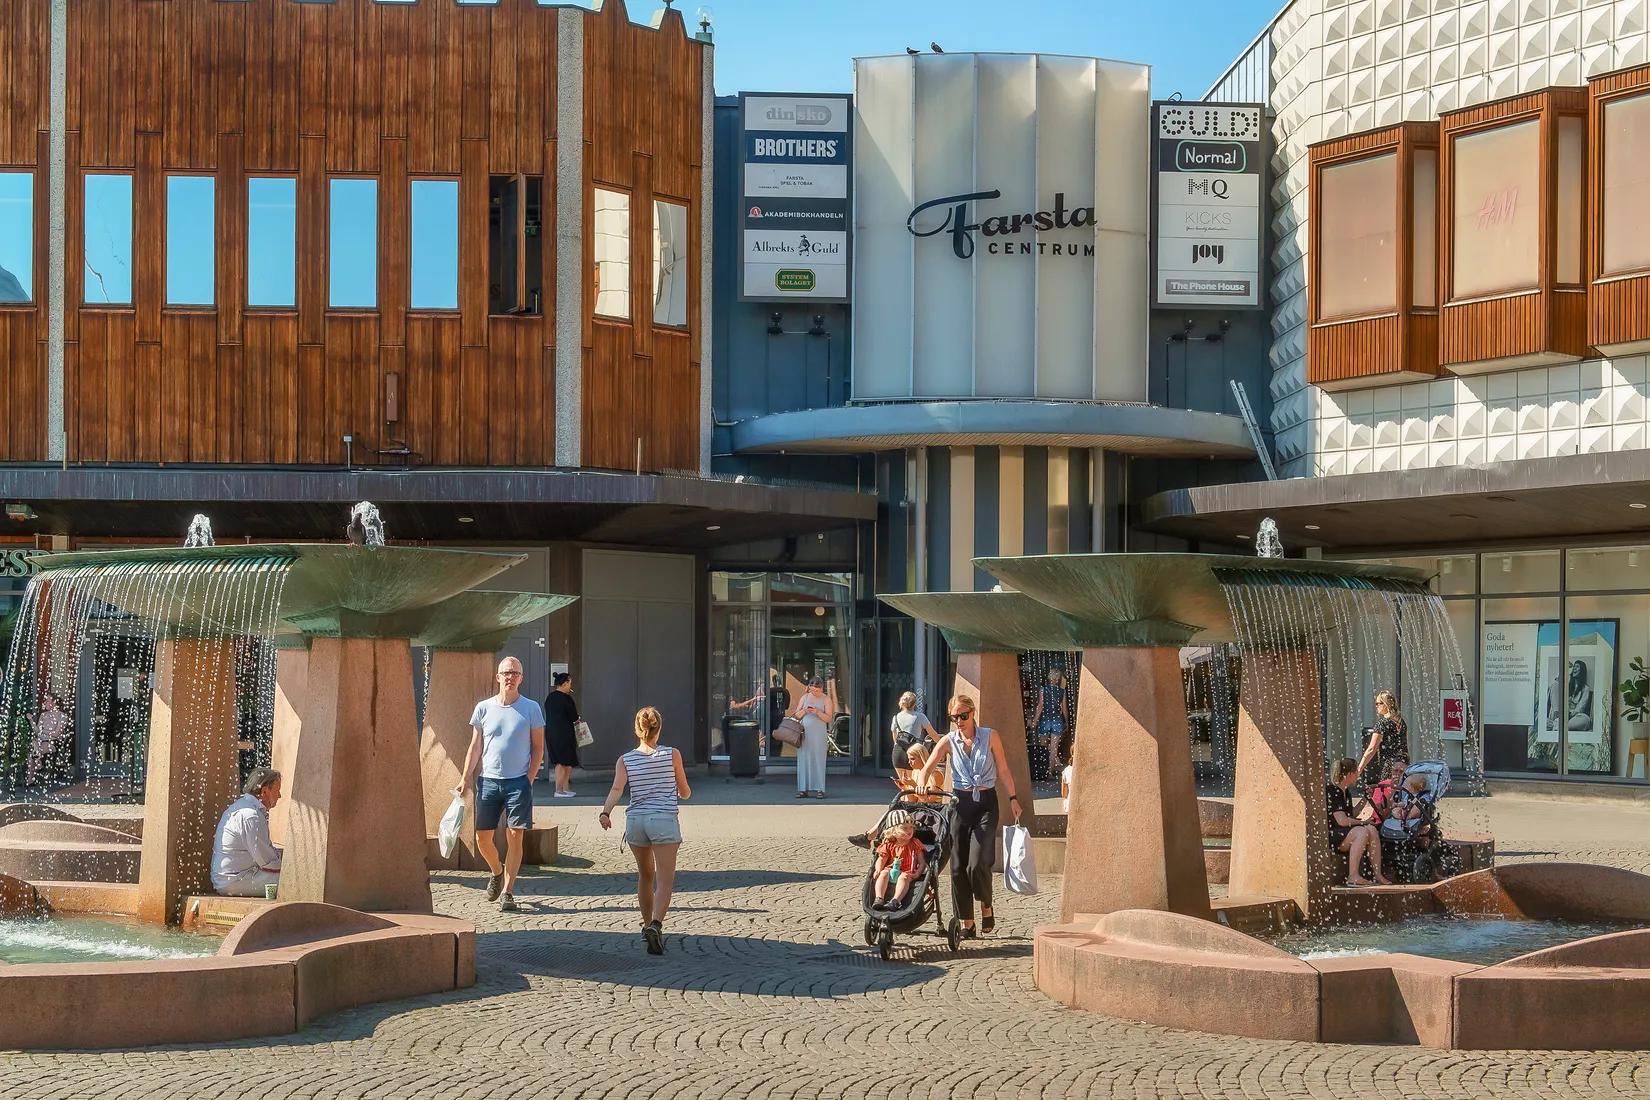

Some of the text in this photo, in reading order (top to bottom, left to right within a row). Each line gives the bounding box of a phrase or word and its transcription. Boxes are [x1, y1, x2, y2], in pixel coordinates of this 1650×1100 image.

[1161, 109, 1258, 137] GULD!
[755, 138, 836, 158] BROTHERS
[1185, 147, 1237, 165] Normal
[1188, 178, 1230, 200] MQ
[764, 211, 844, 219] AKADEMIBOKHANDELN
[1476, 187, 1518, 230] H&M
[907, 189, 1097, 259] Farsta
[1185, 211, 1232, 225] KICKS
[752, 241, 839, 254] Albrekts Guld
[989, 242, 1095, 257] CENTRUM
[1171, 282, 1245, 291] The Phone House
[1486, 632, 1506, 641] Goda
[1486, 643, 1514, 653] nyheter!
